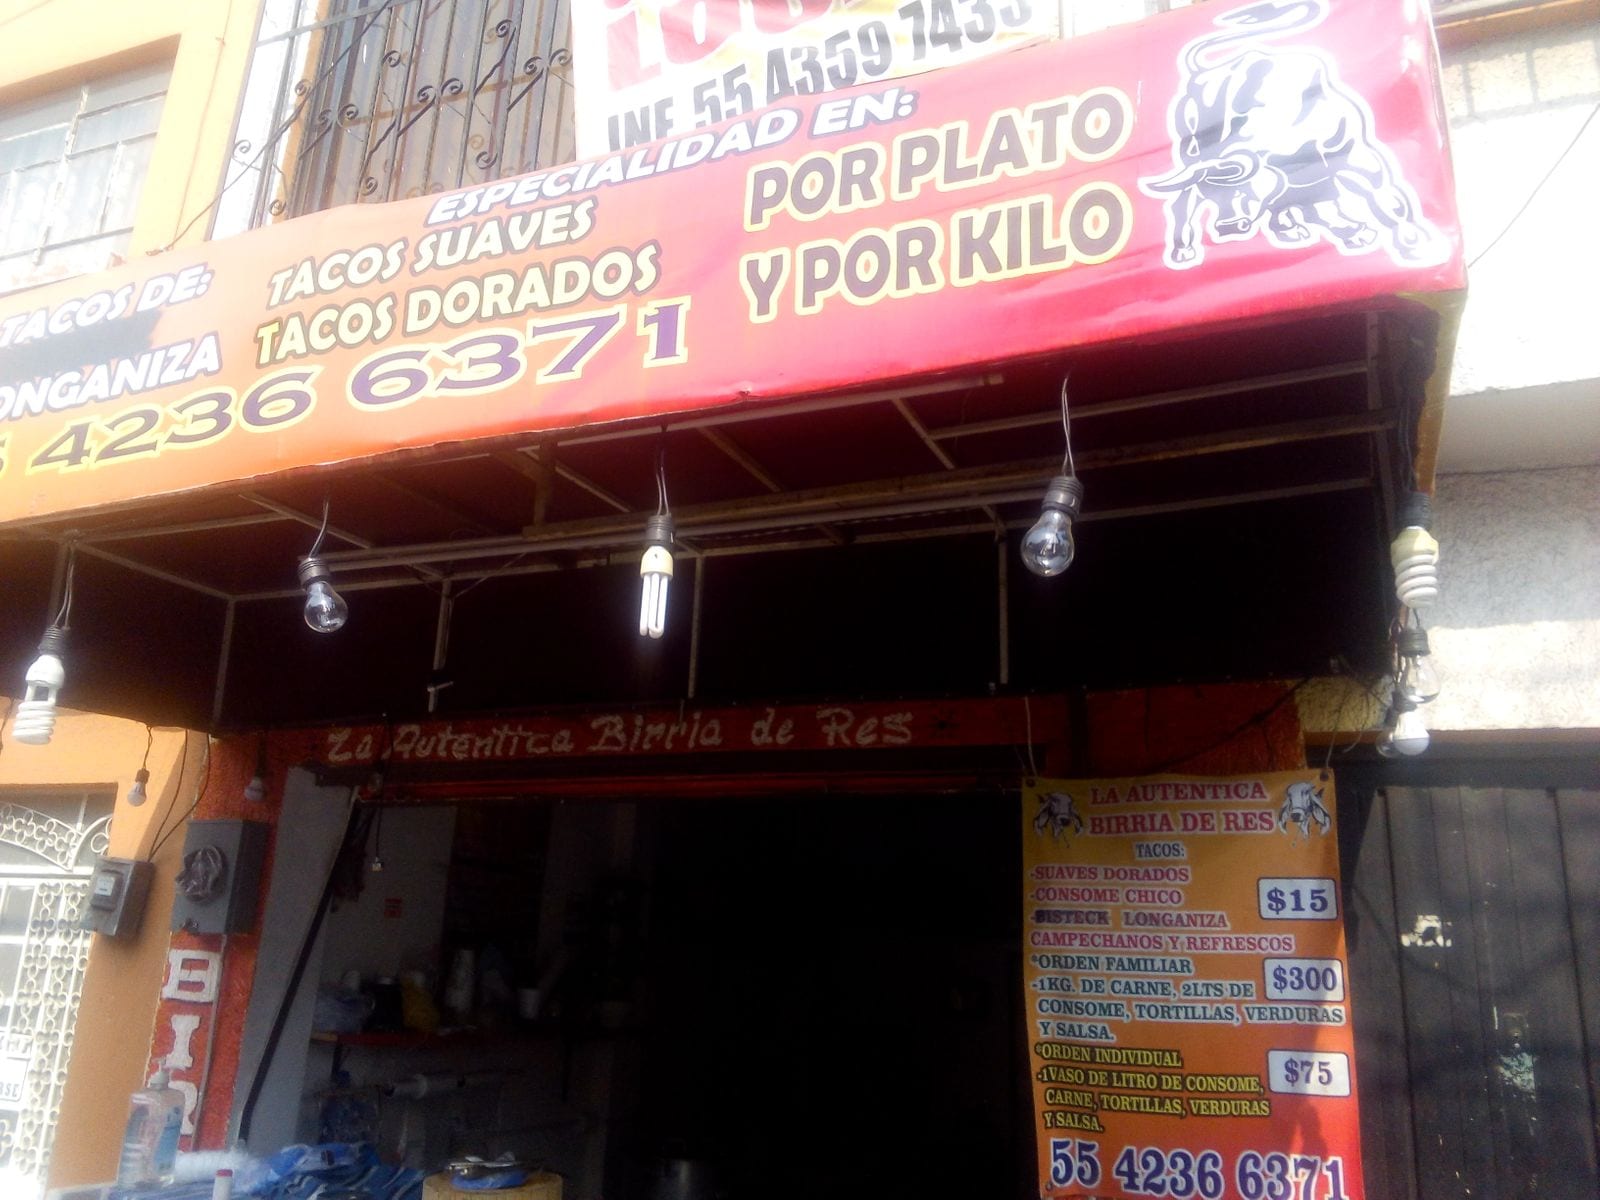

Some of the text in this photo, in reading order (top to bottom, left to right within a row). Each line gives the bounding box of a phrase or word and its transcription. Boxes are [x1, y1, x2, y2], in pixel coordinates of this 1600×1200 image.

[765, 20, 892, 102] 4359
[427, 87, 917, 225] ESPECIALIDAD EN:
[745, 87, 1133, 232] POR PLATO
[267, 197, 598, 309] TACOS SUAVES
[739, 182, 1132, 323] Y POR KILO
[0, 262, 215, 349] TACOS DE:
[256, 241, 661, 367] TACOS DORADOS
[26, 365, 324, 476] 4236
[346, 296, 691, 411] 6371
[589, 711, 723, 752] Birria
[751, 708, 794, 746] de
[817, 707, 913, 746] Res
[1091, 782, 1267, 805] LA AUTENTICA
[1089, 811, 1274, 835] BIRRIA DE RES
[1135, 844, 1185, 859] TACOS:
[1104, 867, 1189, 882] DORADOS
[1125, 889, 1182, 904] CHICO
[1266, 888, 1329, 915] $15
[1123, 911, 1228, 928] LONGANIZA
[1031, 931, 1293, 951] CAMPECHANOS Y REFRESCOS
[1105, 957, 1192, 974] FAMILIAR
[1272, 964, 1338, 993] $300
[1082, 979, 1105, 995] DE
[1111, 980, 1176, 999] CARNE,
[1182, 983, 1223, 997] 2LTS
[1229, 983, 1254, 998] DE
[1038, 999, 1343, 1024] CONSOME, TORTILLAS, VERDURAS
[1039, 1022, 1115, 1040] Y SALSA.
[1095, 1048, 1182, 1066] INDIVIDUAL
[1088, 1071, 1108, 1086] DE
[1112, 1073, 1157, 1089] LITRO
[1162, 1075, 1182, 1090] DE
[1186, 1076, 1265, 1095] CONSOME,
[1284, 1057, 1334, 1087] $75
[1046, 1089, 1270, 1116] CARNE, TORTILLAS, VERDURAS
[1044, 1112, 1104, 1131] Y SALSA.
[1051, 1138, 1349, 1200] 55 4236 6371
